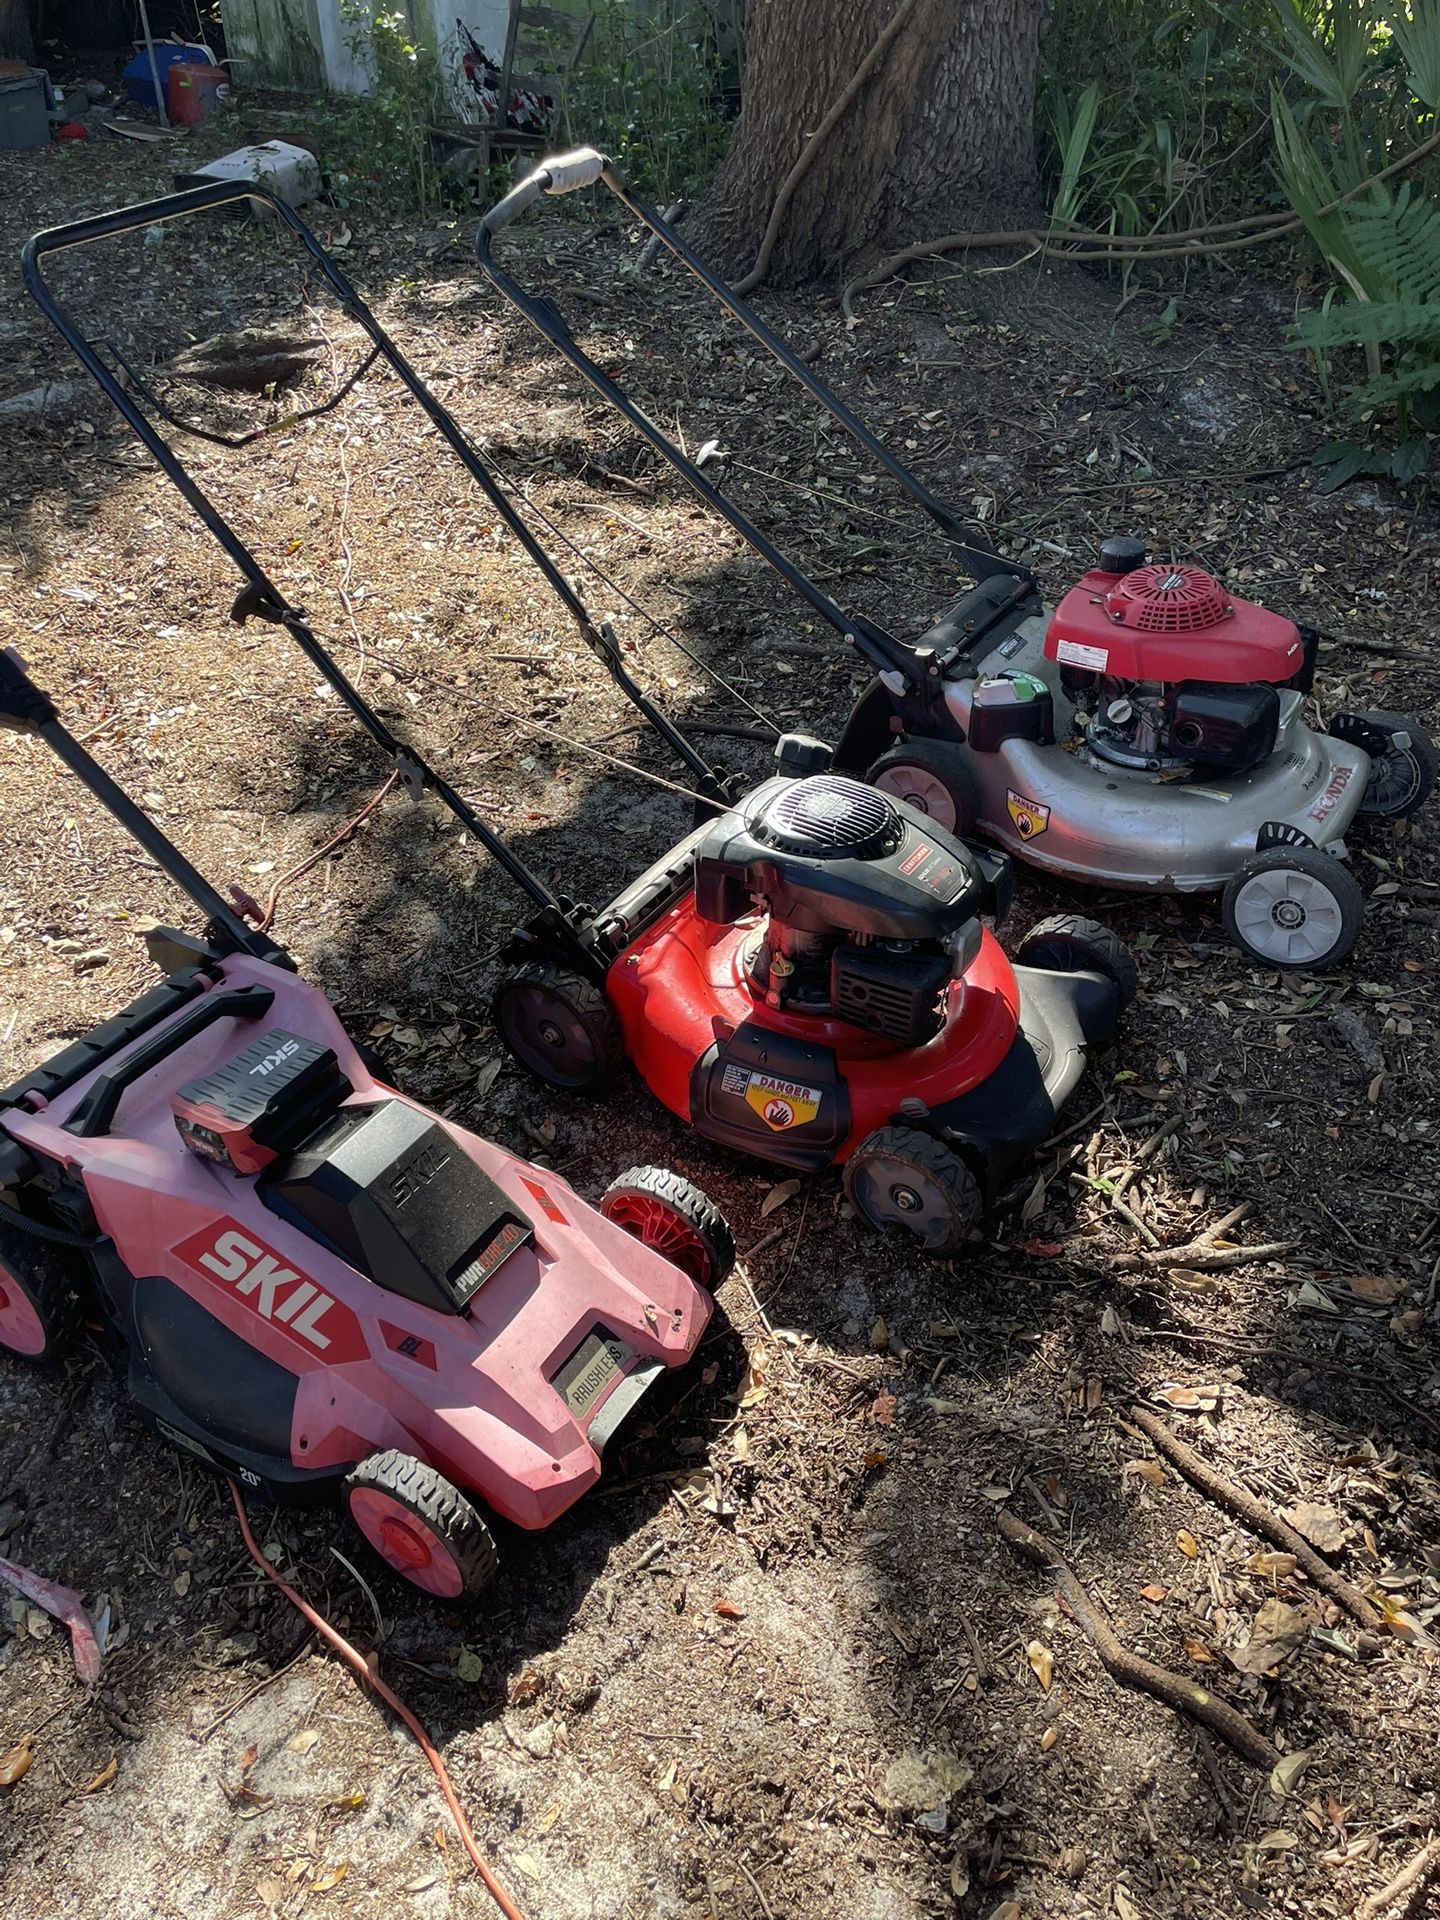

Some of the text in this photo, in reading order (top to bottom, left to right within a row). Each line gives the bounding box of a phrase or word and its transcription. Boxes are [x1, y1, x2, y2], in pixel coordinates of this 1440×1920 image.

[1012, 794, 1041, 815] DANGER
[1307, 767, 1354, 824] HONDA
[249, 1039, 300, 1076] SKIL
[760, 1075, 812, 1099] DANGER
[389, 1144, 450, 1208] SKIL
[454, 1225, 519, 1293] PWRCORE 40
[198, 1230, 336, 1350] SKIL
[572, 1346, 622, 1405] BRUSHLESS
[239, 1467, 261, 1486] 20"
